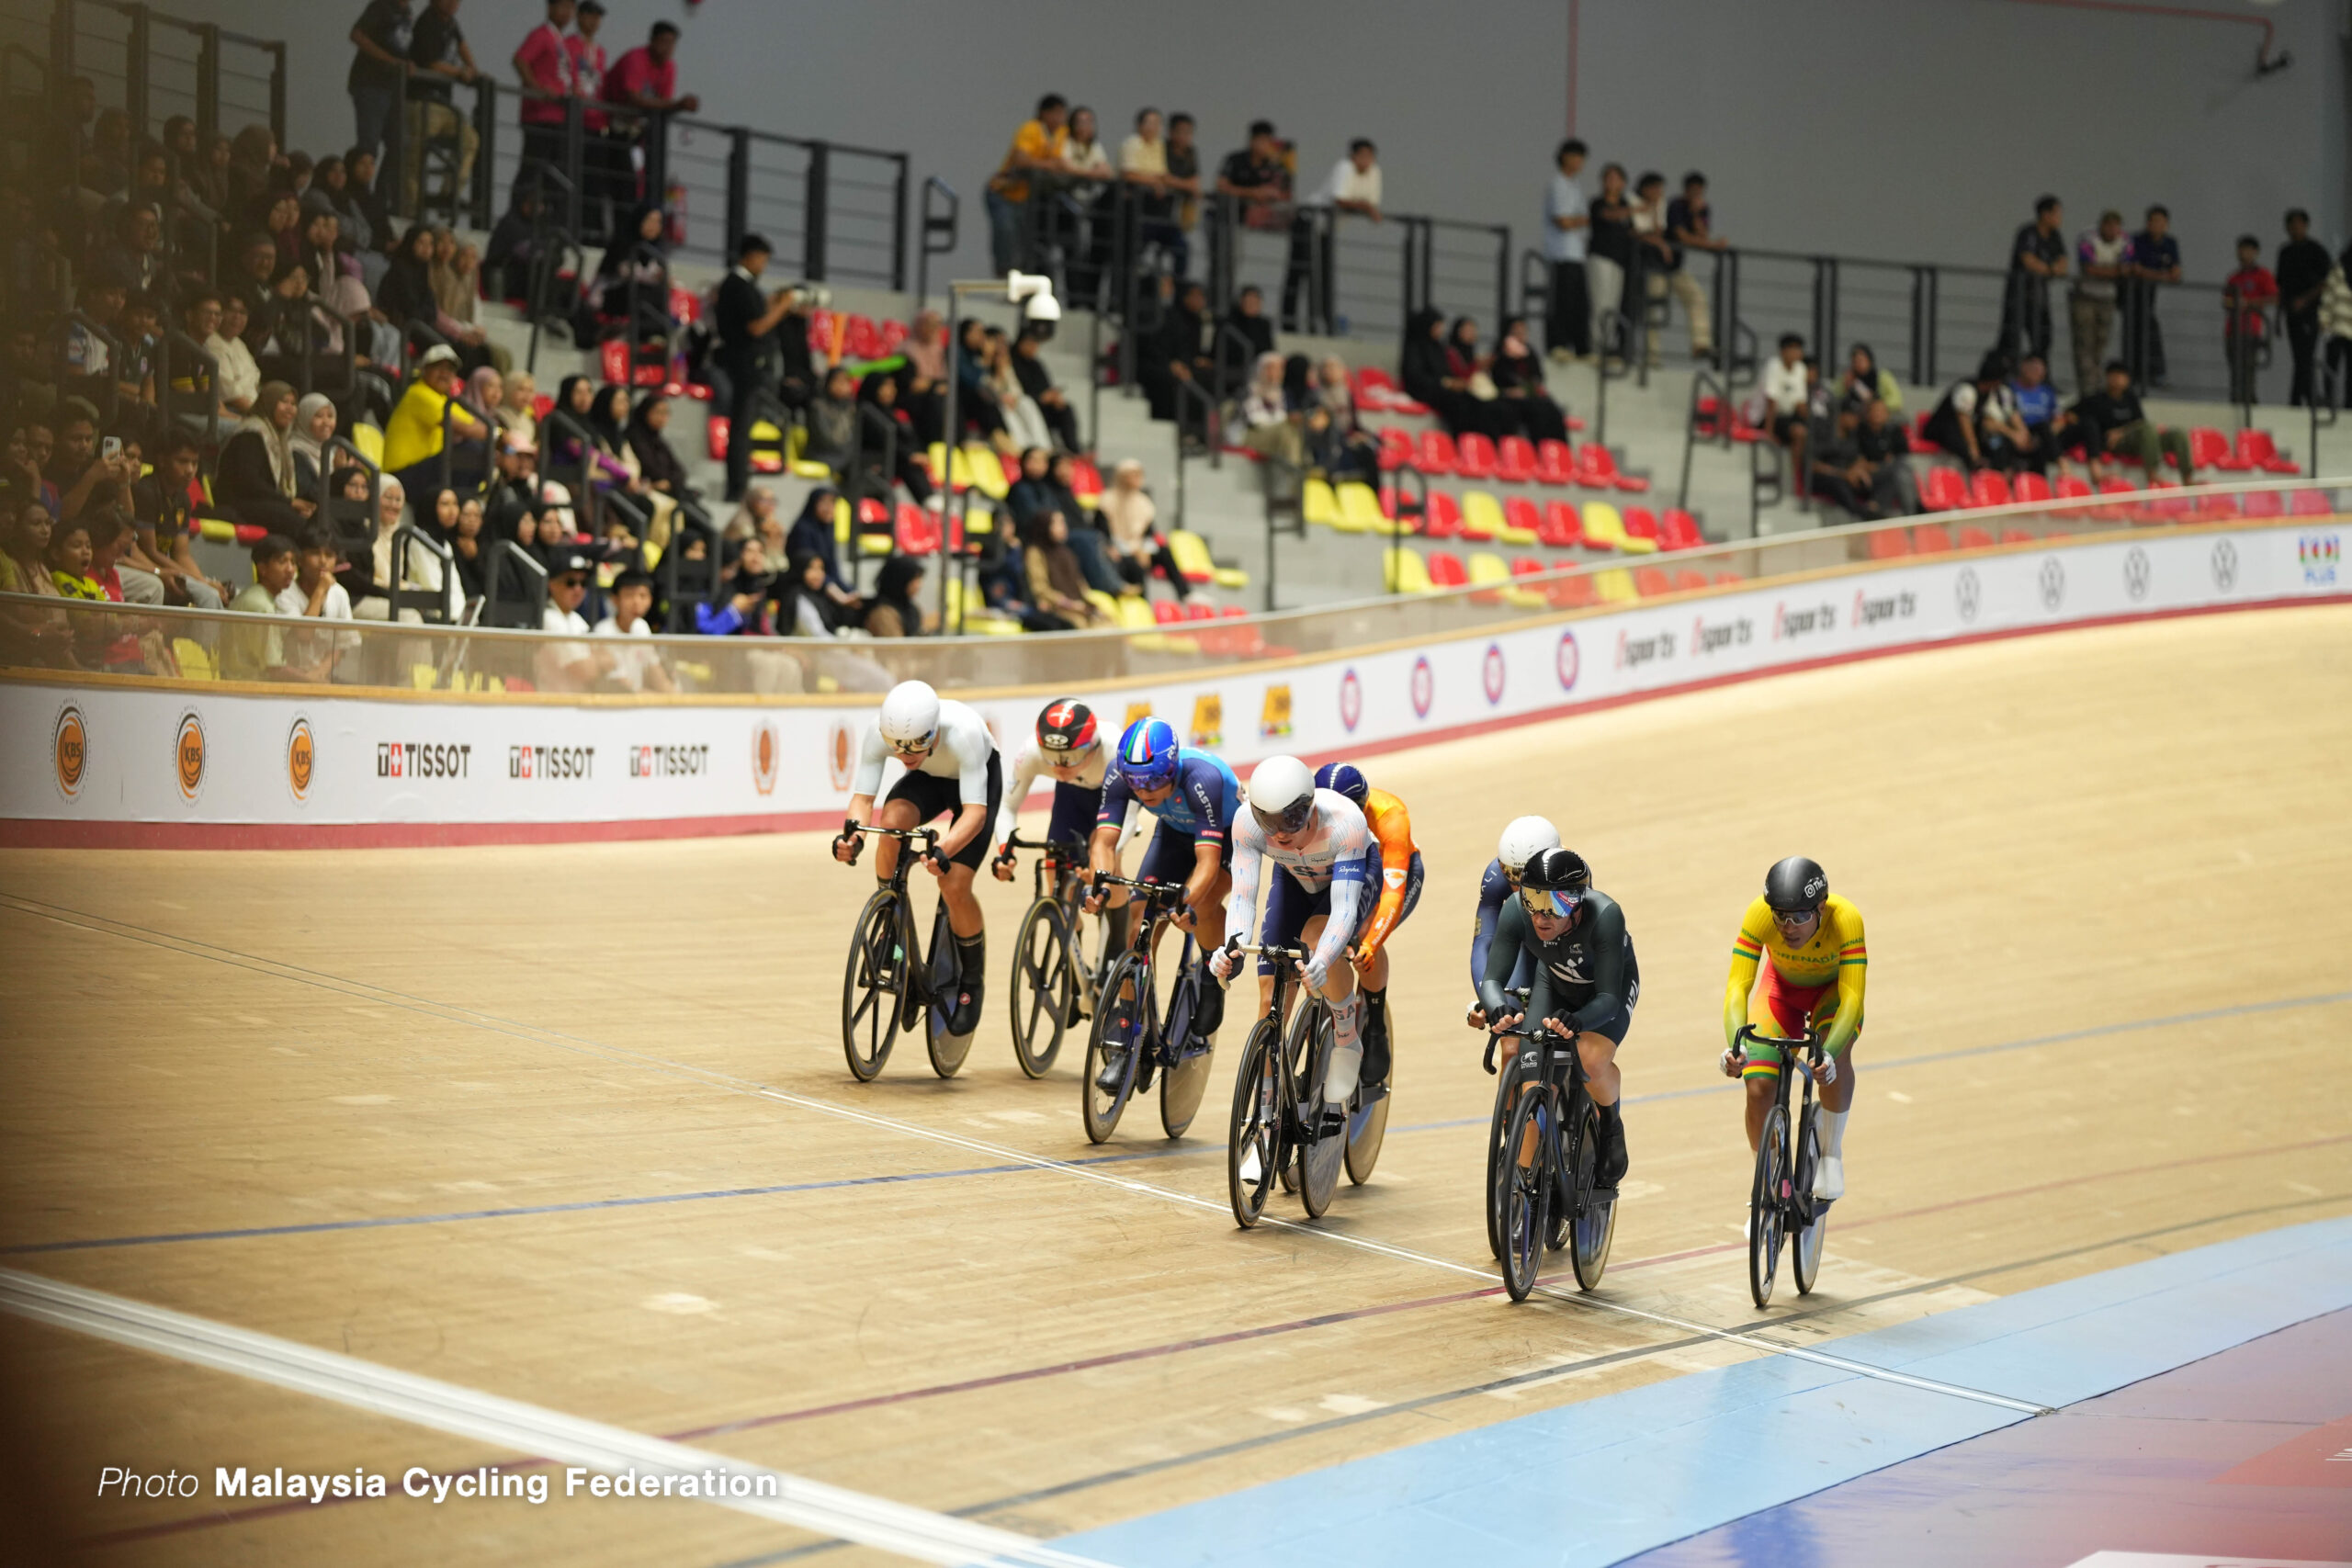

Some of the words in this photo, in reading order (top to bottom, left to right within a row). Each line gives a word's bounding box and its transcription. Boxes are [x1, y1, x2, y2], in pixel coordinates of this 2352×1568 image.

[64, 741, 81, 761] KBS
[185, 747, 201, 765] KBS
[296, 750, 311, 768] KBS
[405, 743, 470, 778] TISSOT
[536, 746, 594, 778] TISSOT
[654, 745, 708, 777] TISSOT
[1193, 783, 1216, 827] CASTELLI
[1338, 865, 1361, 875] Rapha
[1625, 980, 1639, 1018] NZL
